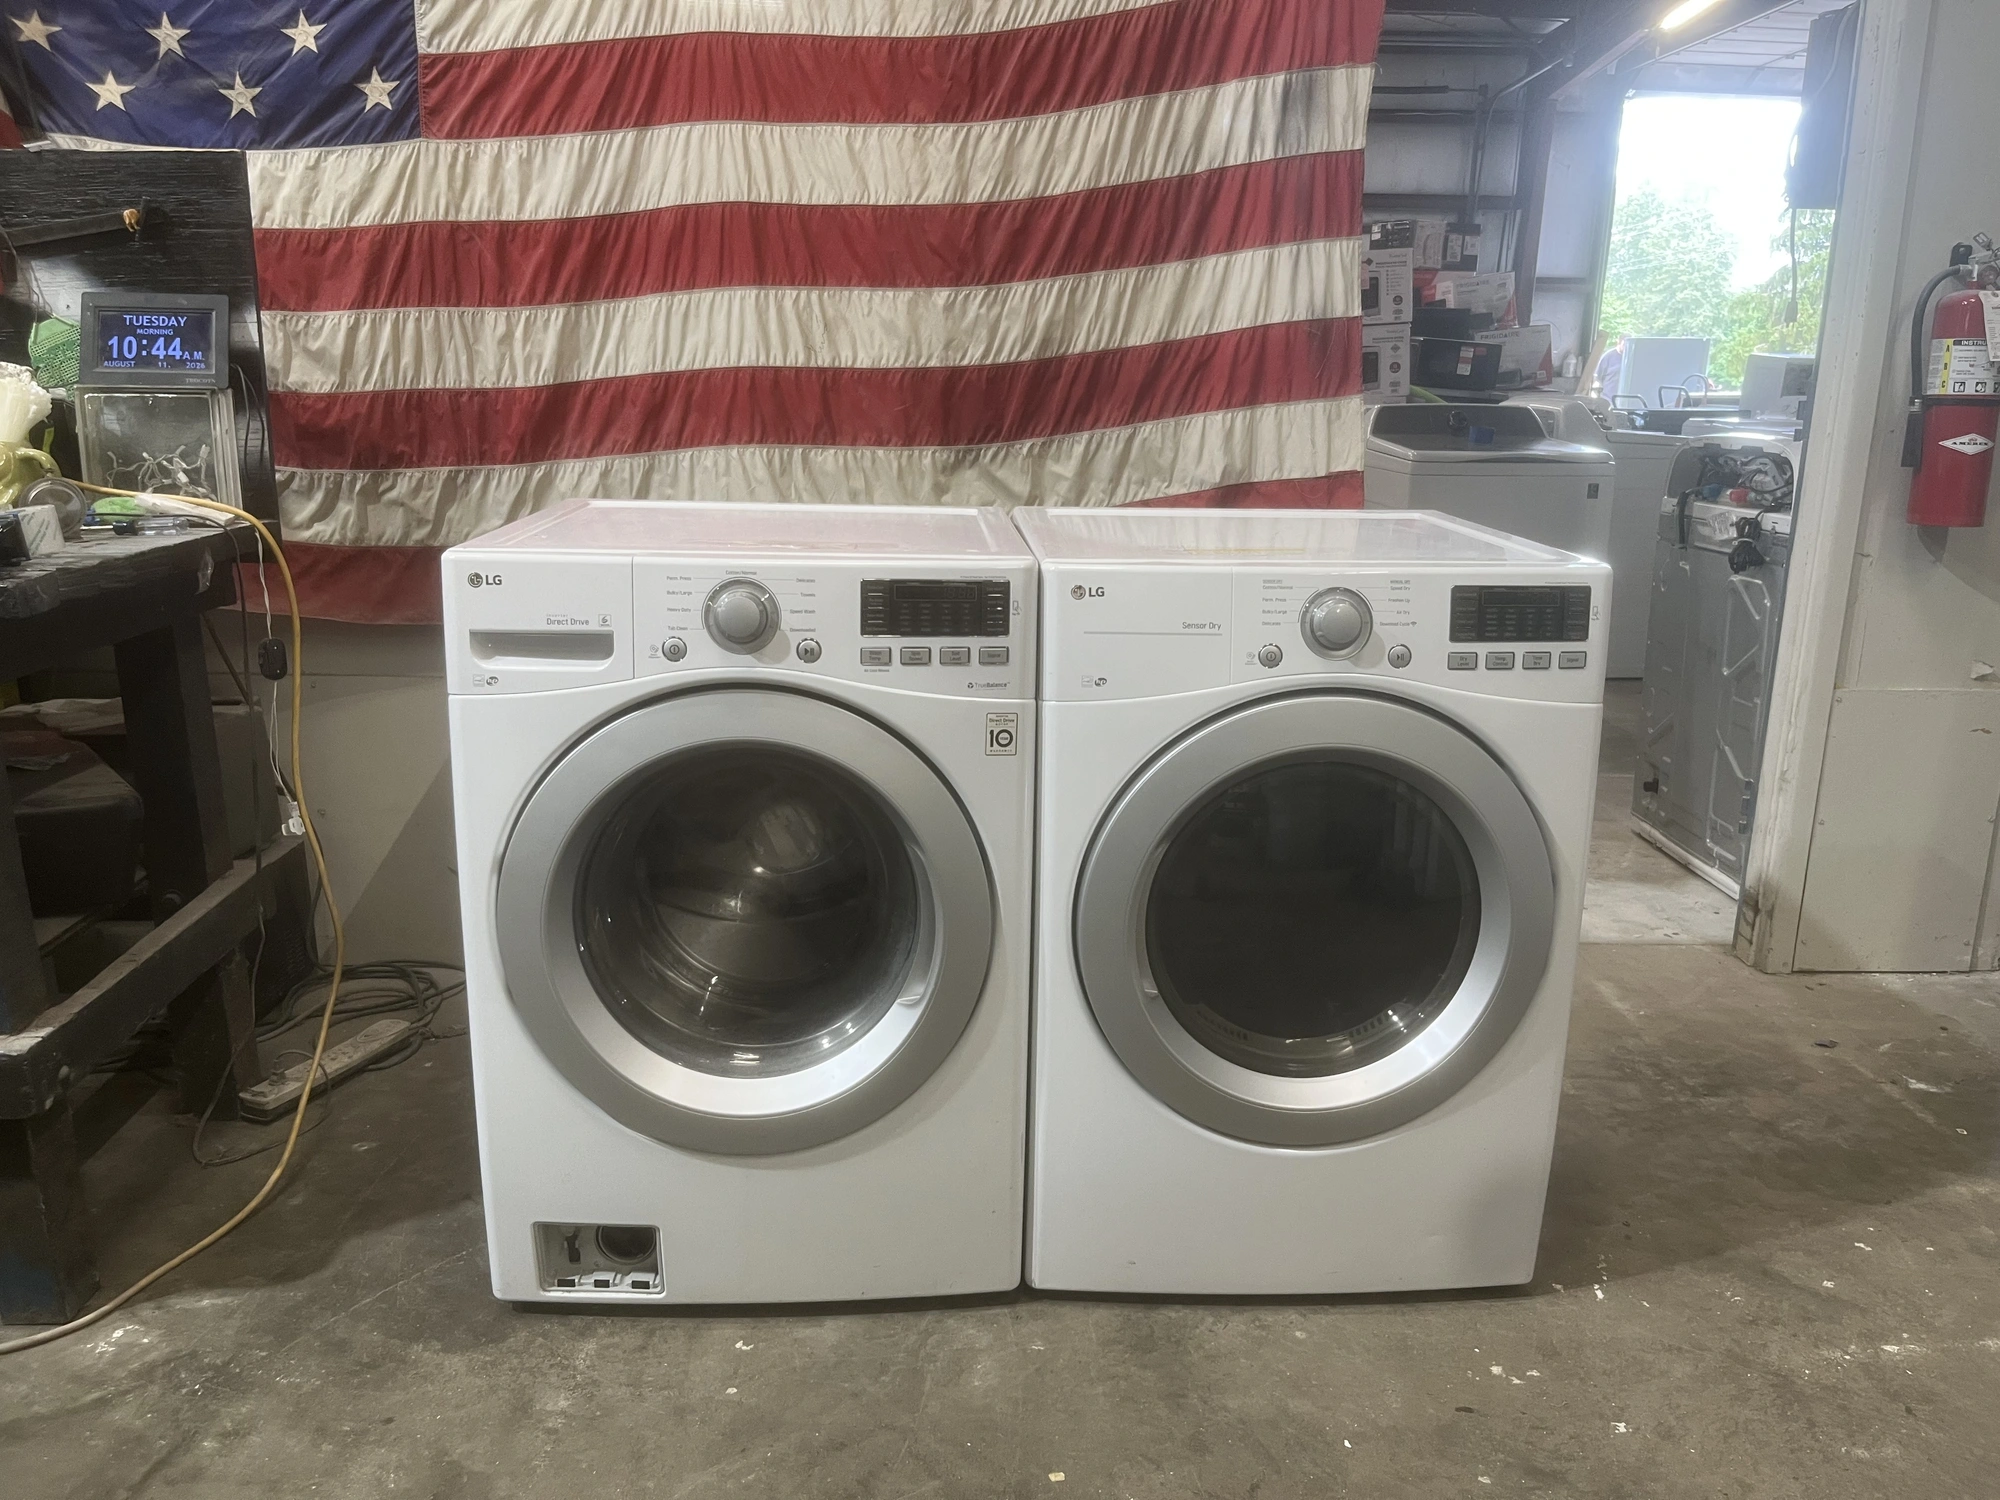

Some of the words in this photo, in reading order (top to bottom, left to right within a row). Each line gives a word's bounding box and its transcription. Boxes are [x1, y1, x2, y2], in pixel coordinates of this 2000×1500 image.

[123, 315, 187, 327] TUESDAY
[136, 328, 174, 336] MORNING
[1481, 331, 1520, 340] FRIGIDAIRE
[107, 336, 183, 360] 10:44
[1945, 344, 1950, 353] A
[1943, 362, 1948, 370] B
[1941, 380, 1946, 388] C
[485, 574, 503, 586] LG
[1088, 586, 1105, 598] LG
[546, 617, 569, 626] Direct
[570, 617, 590, 626] Drive
[1182, 621, 1207, 630] Sensor
[1208, 622, 1222, 631] Dry
[989, 729, 1014, 748] 10
